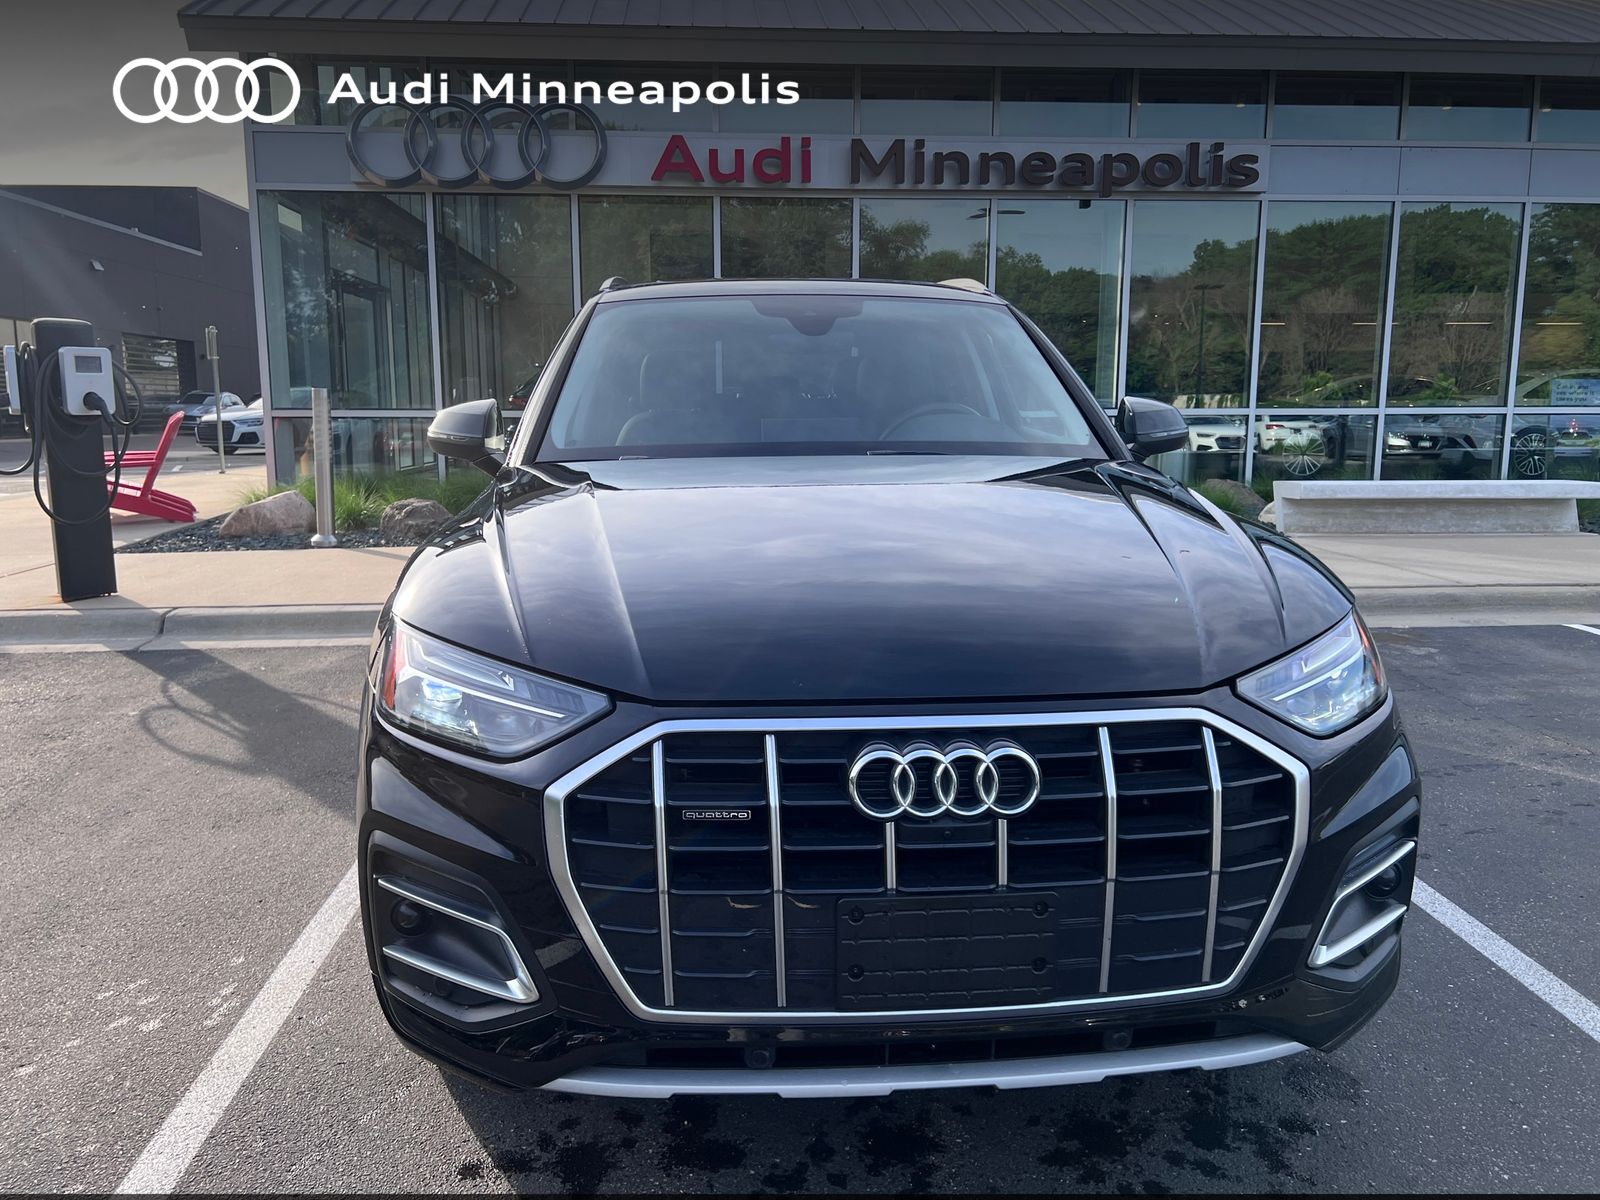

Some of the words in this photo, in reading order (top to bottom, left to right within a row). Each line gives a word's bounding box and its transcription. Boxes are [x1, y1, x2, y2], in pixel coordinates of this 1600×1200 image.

[651, 134, 812, 183] Audi
[850, 138, 1260, 198] Minneapolis
[685, 811, 748, 819] quattro
